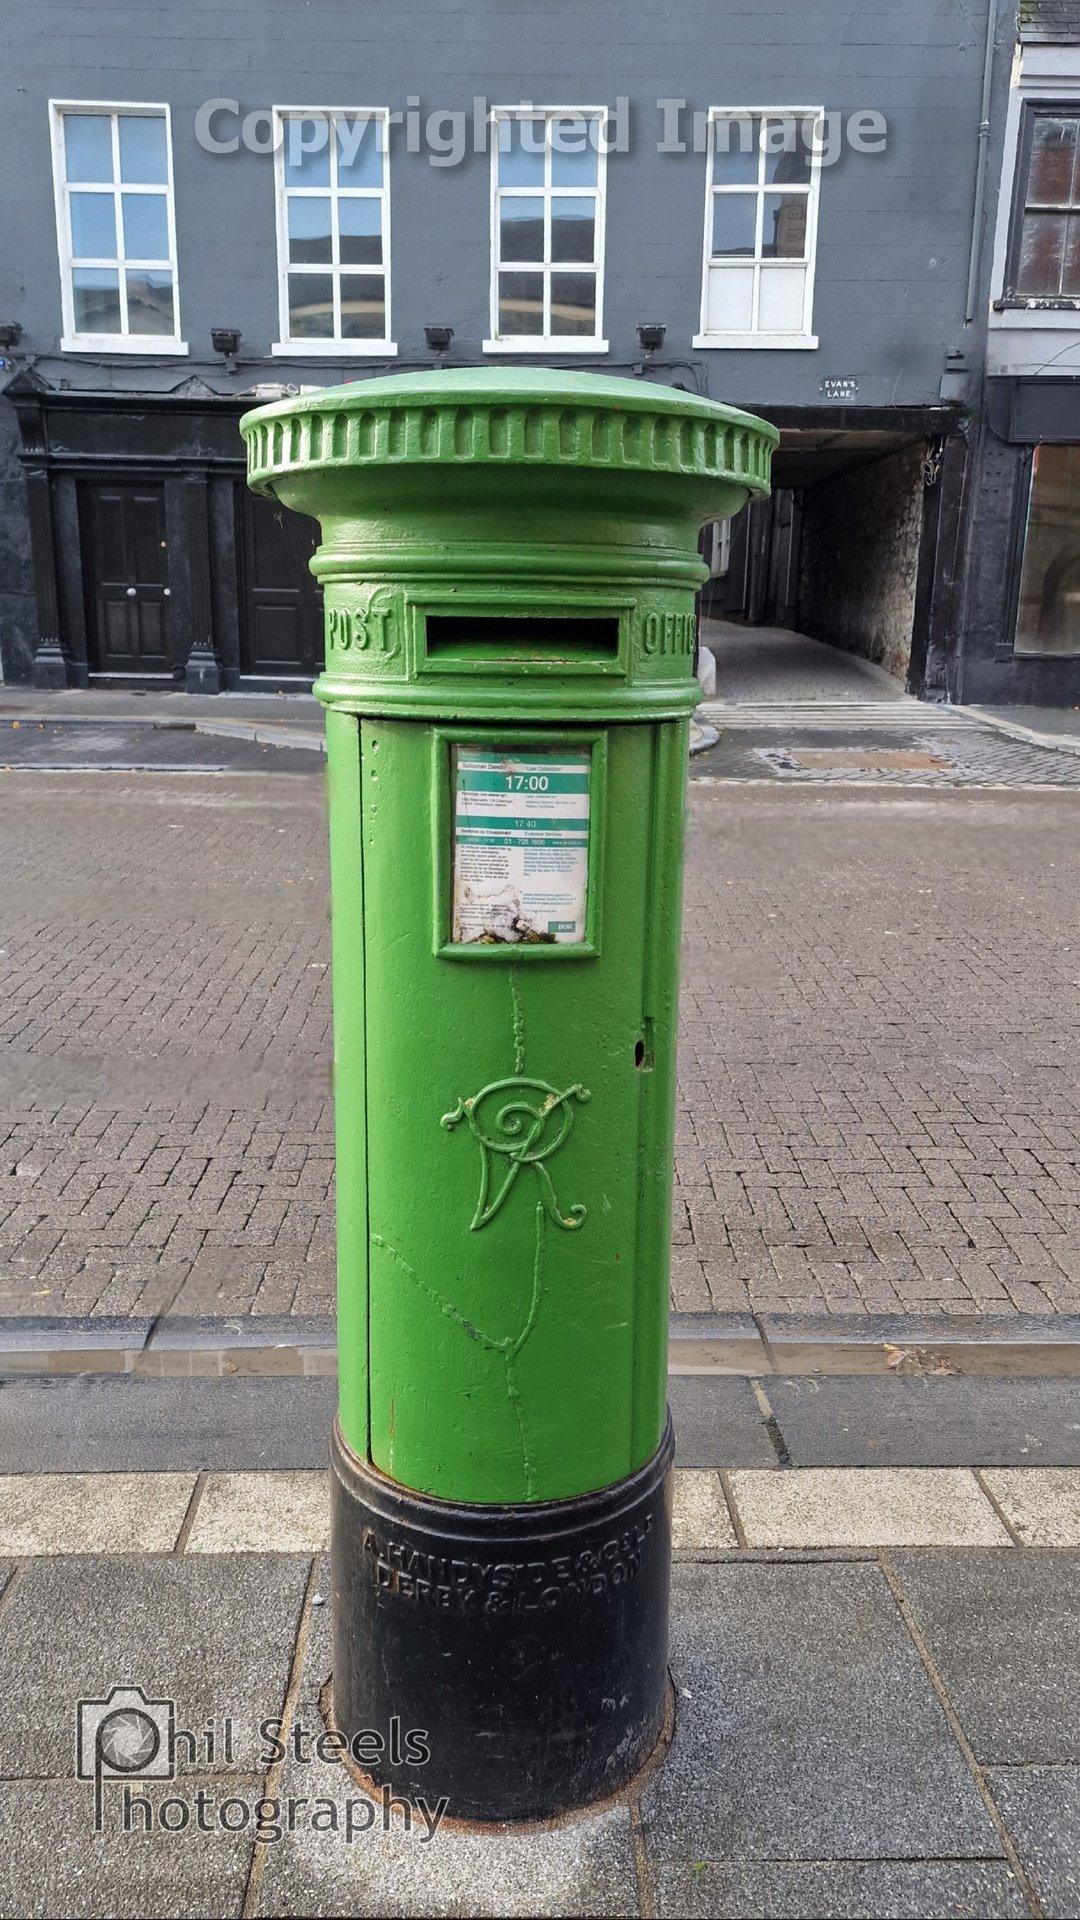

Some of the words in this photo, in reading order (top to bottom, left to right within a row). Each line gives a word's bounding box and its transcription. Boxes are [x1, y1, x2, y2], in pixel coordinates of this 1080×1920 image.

[825, 380, 856, 388] EVAN'S
[827, 390, 851, 398] LANE
[328, 609, 393, 653] POST
[504, 775, 549, 791] 17:00
[514, 820, 537, 828] 17:40
